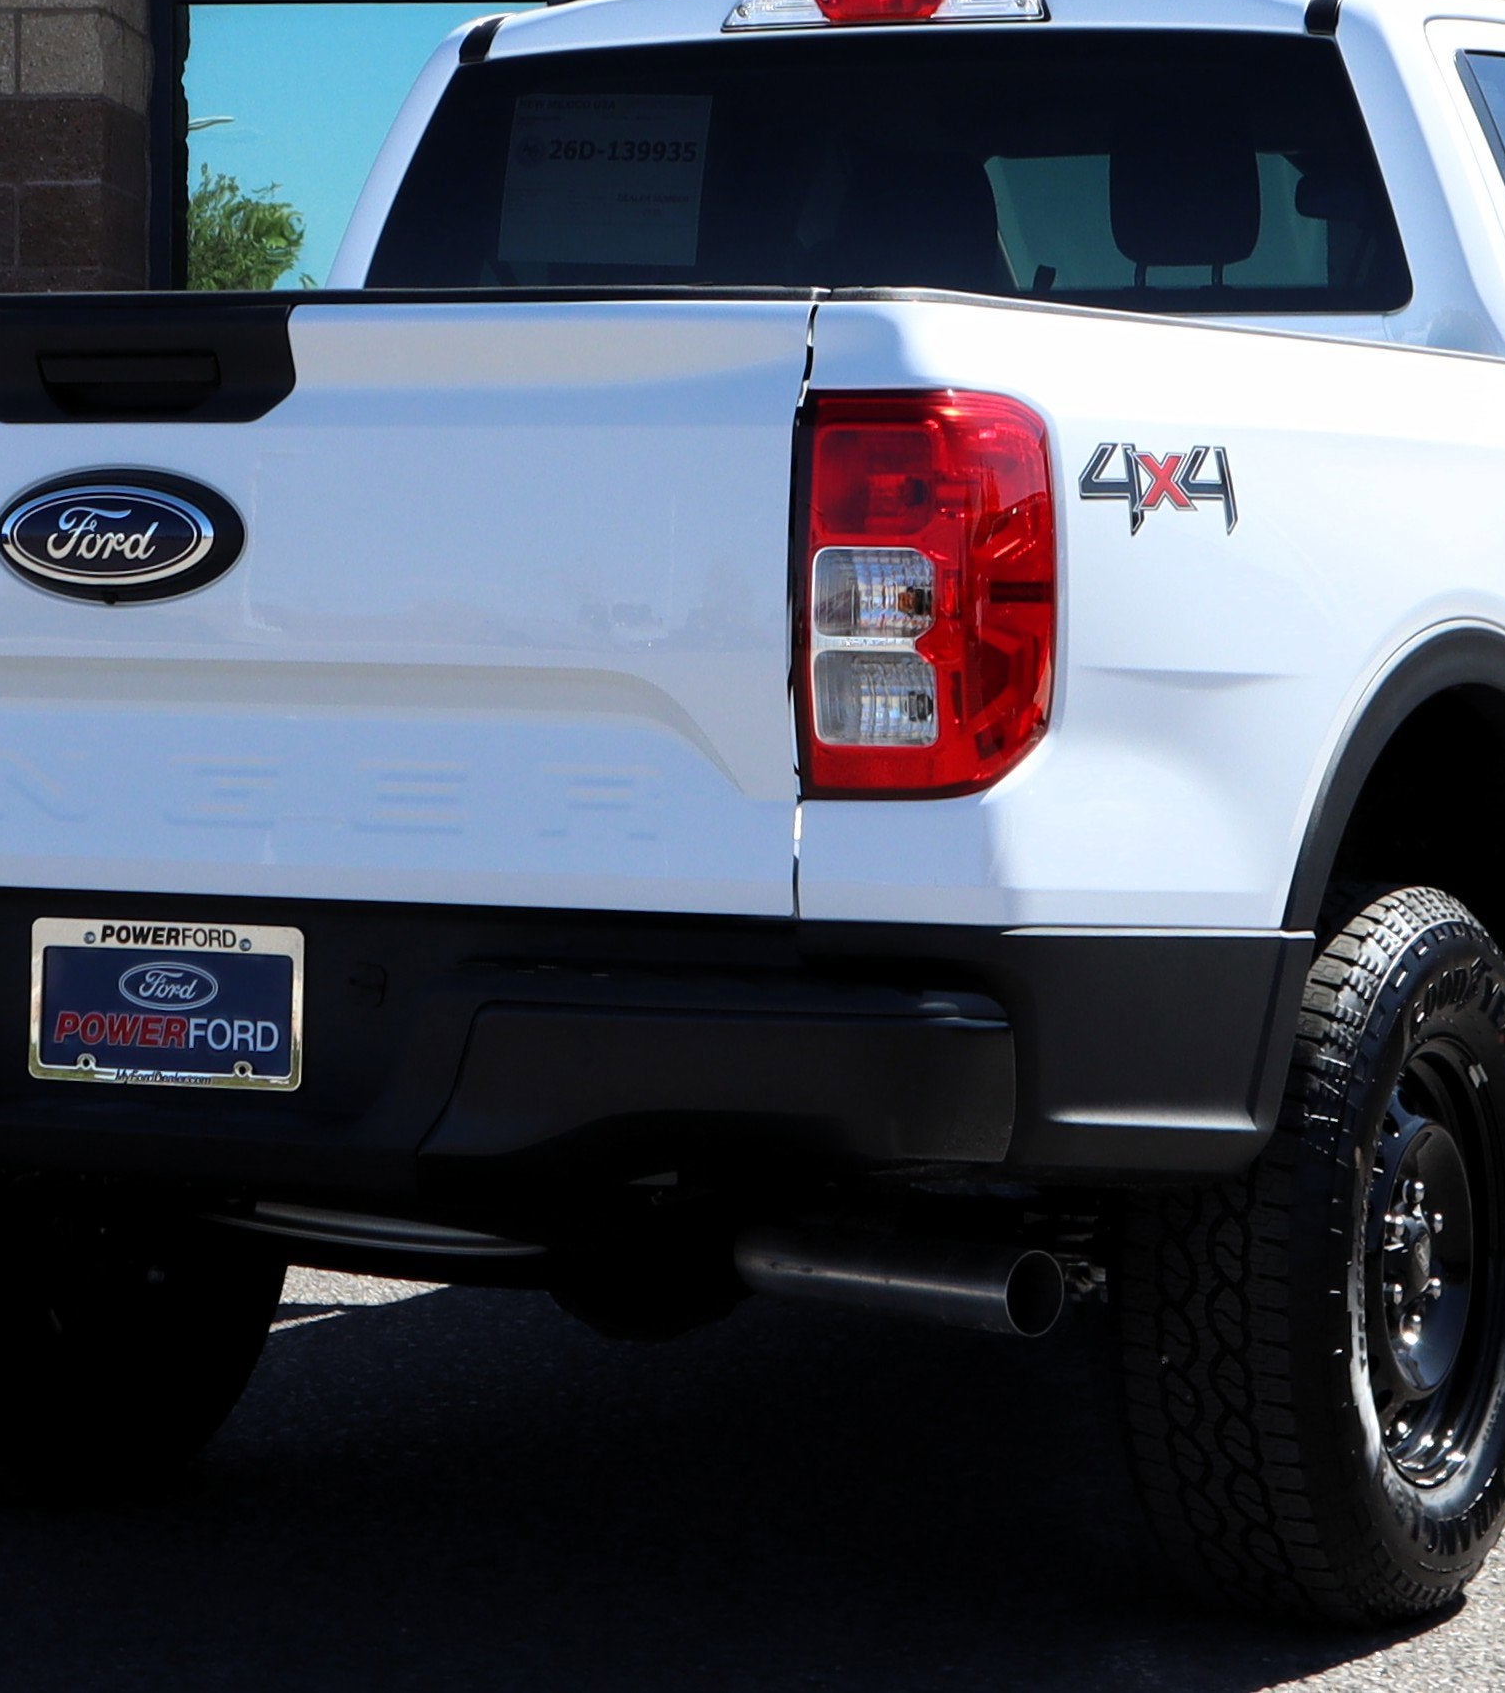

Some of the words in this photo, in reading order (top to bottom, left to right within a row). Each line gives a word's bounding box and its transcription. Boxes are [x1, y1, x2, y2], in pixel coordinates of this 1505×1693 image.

[46, 506, 159, 561] Ford
[100, 924, 237, 949] POWERFORD
[138, 969, 198, 1001] Ford
[53, 1010, 280, 1053] POWERFORD
